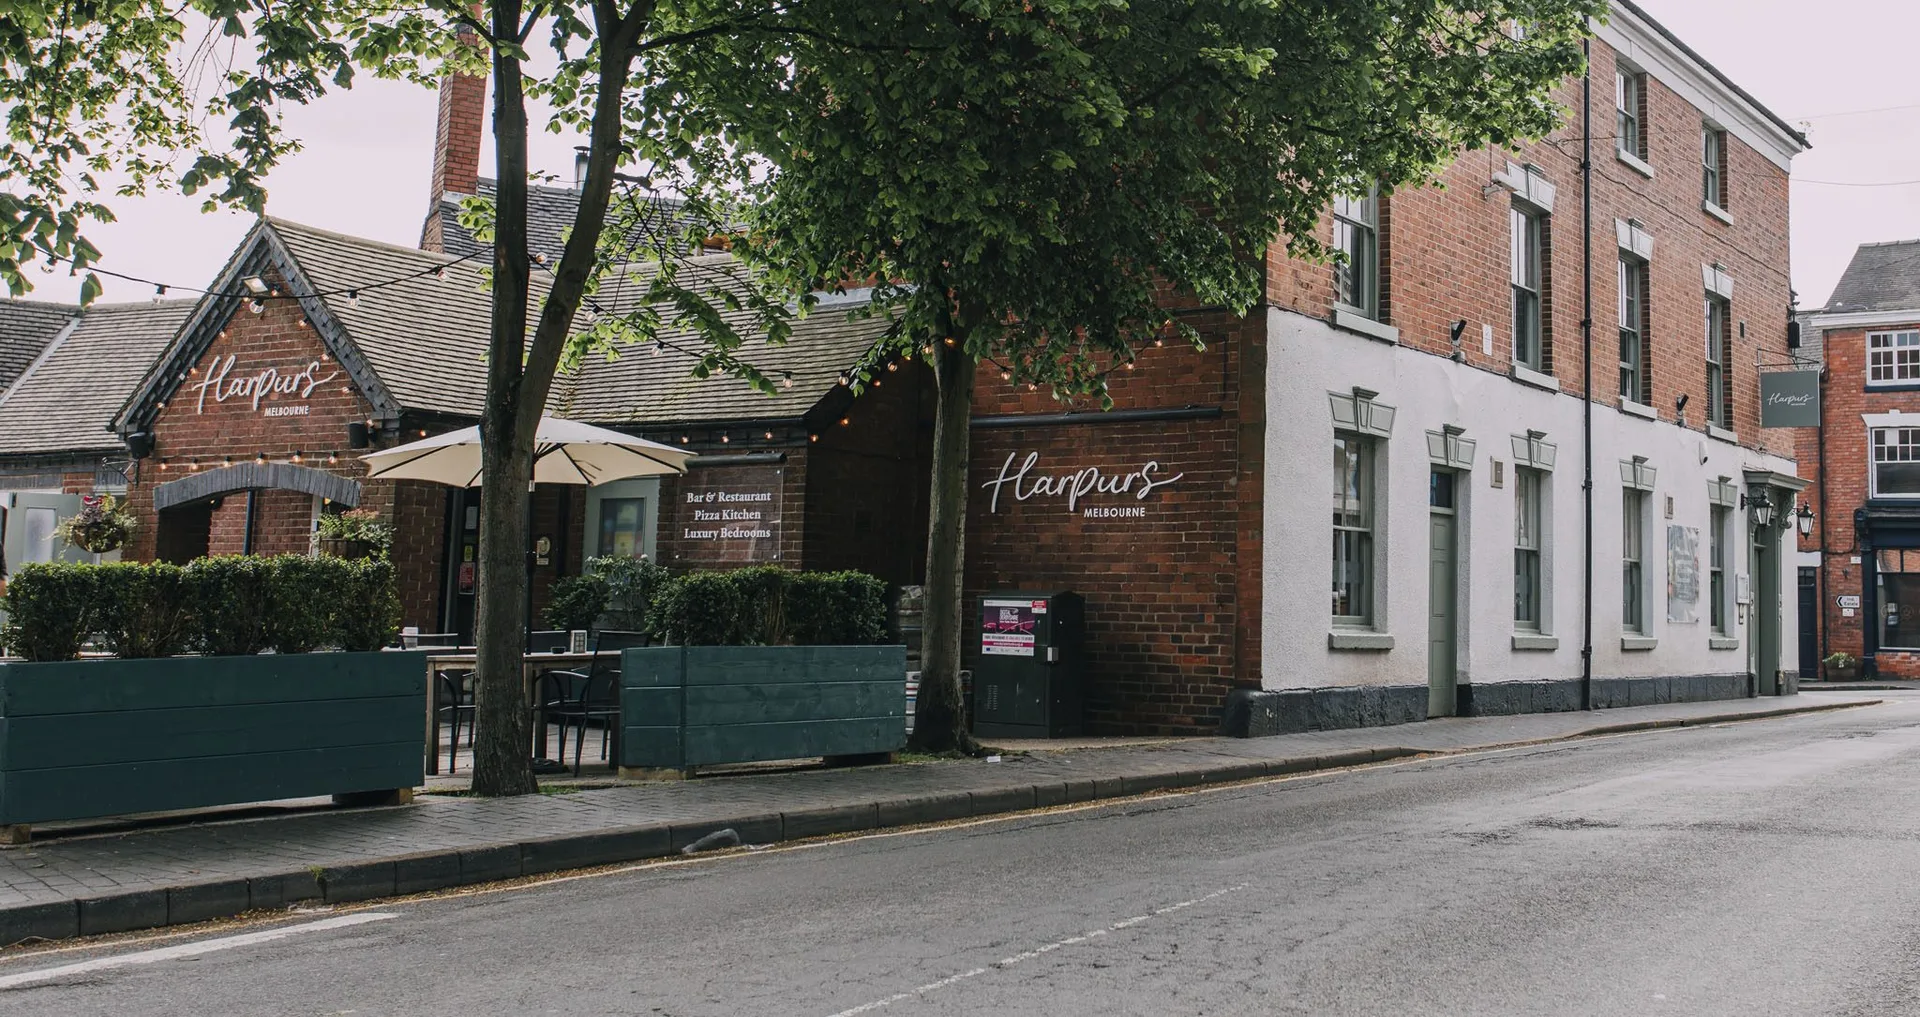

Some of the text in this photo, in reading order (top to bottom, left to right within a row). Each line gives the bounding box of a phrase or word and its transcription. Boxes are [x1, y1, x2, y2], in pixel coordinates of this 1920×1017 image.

[191, 354, 339, 415] Harpurs
[1767, 392, 1815, 406] Harpurs
[264, 405, 310, 417] MELBOURNE
[981, 451, 1184, 514] Harpurs
[686, 491, 772, 503] Bar & Restaurant
[694, 508, 761, 520] Pizza Kitchen
[1083, 507, 1146, 518] MELBOURNE
[683, 526, 771, 541] Luxury Bedrooms
